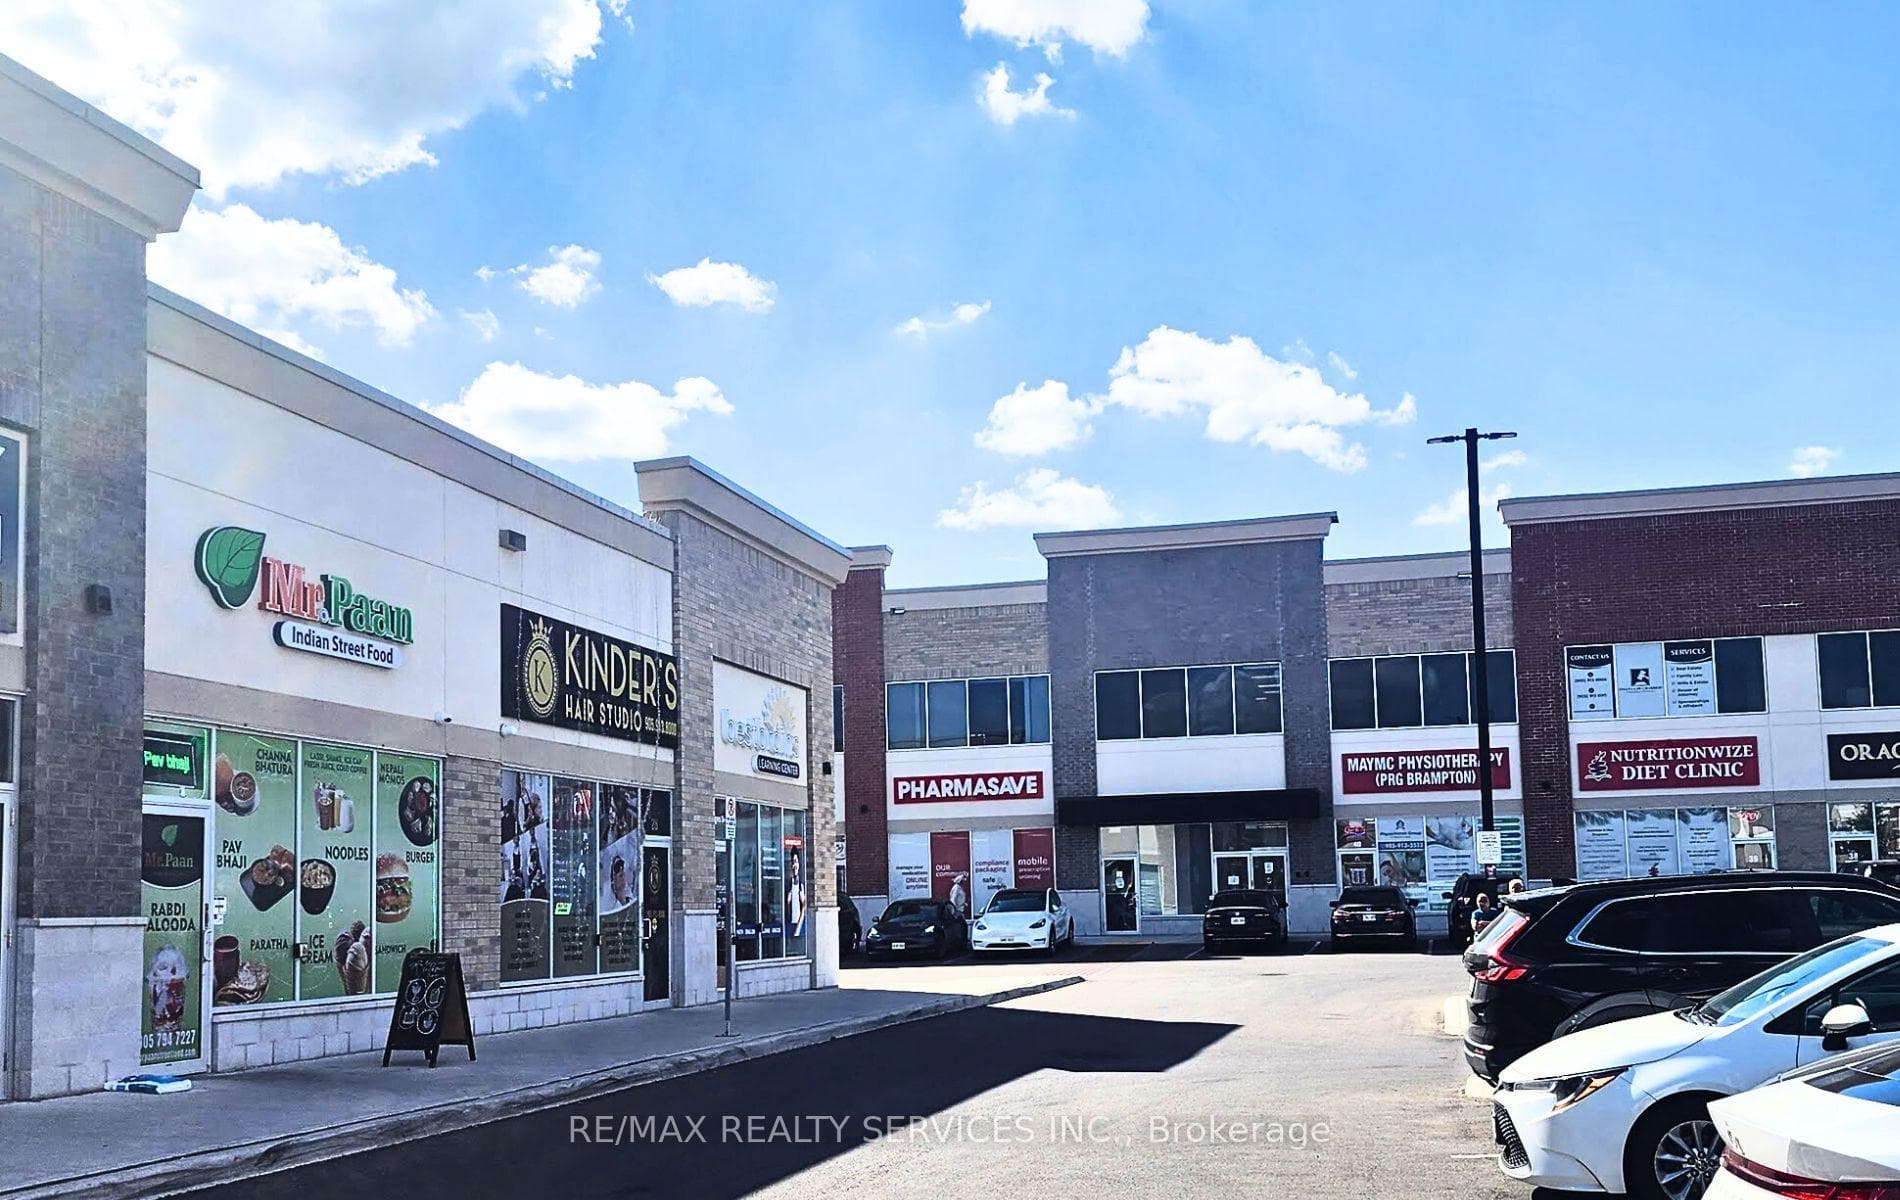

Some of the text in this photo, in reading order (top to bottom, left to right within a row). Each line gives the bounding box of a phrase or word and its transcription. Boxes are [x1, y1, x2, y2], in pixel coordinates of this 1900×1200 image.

[292, 625, 393, 664] Indian Street Food
[1670, 648, 1706, 656] SERVICES
[533, 659, 549, 696] K
[565, 630, 677, 711] KINDER'S
[565, 693, 594, 723] HAIR
[600, 702, 642, 732] STUDIO
[256, 748, 293, 764] CHANNA
[1610, 744, 1754, 763] NUTRITIONWIZE
[255, 760, 293, 776] BHATURA
[380, 763, 404, 775] NEPALI
[758, 758, 799, 776] LEARNING CENTER
[1347, 756, 1395, 772] MAYMC
[1621, 761, 1744, 781] DIET CLINIC
[379, 772, 406, 786] MOMOS
[1375, 769, 1476, 787] (PRG BRAMPTON)
[897, 775, 1038, 800] PHARMASAVE
[222, 839, 243, 854] PAV
[325, 845, 369, 861] NOODLES
[216, 854, 247, 869] BHAJI
[405, 851, 435, 864] BURGER
[1017, 856, 1048, 866] mobile
[974, 866, 1007, 874] packaging
[151, 902, 187, 917] RABDI
[250, 939, 289, 952] PARATHA
[309, 934, 325, 950] ICE
[175, 1029, 196, 1046] 7227
